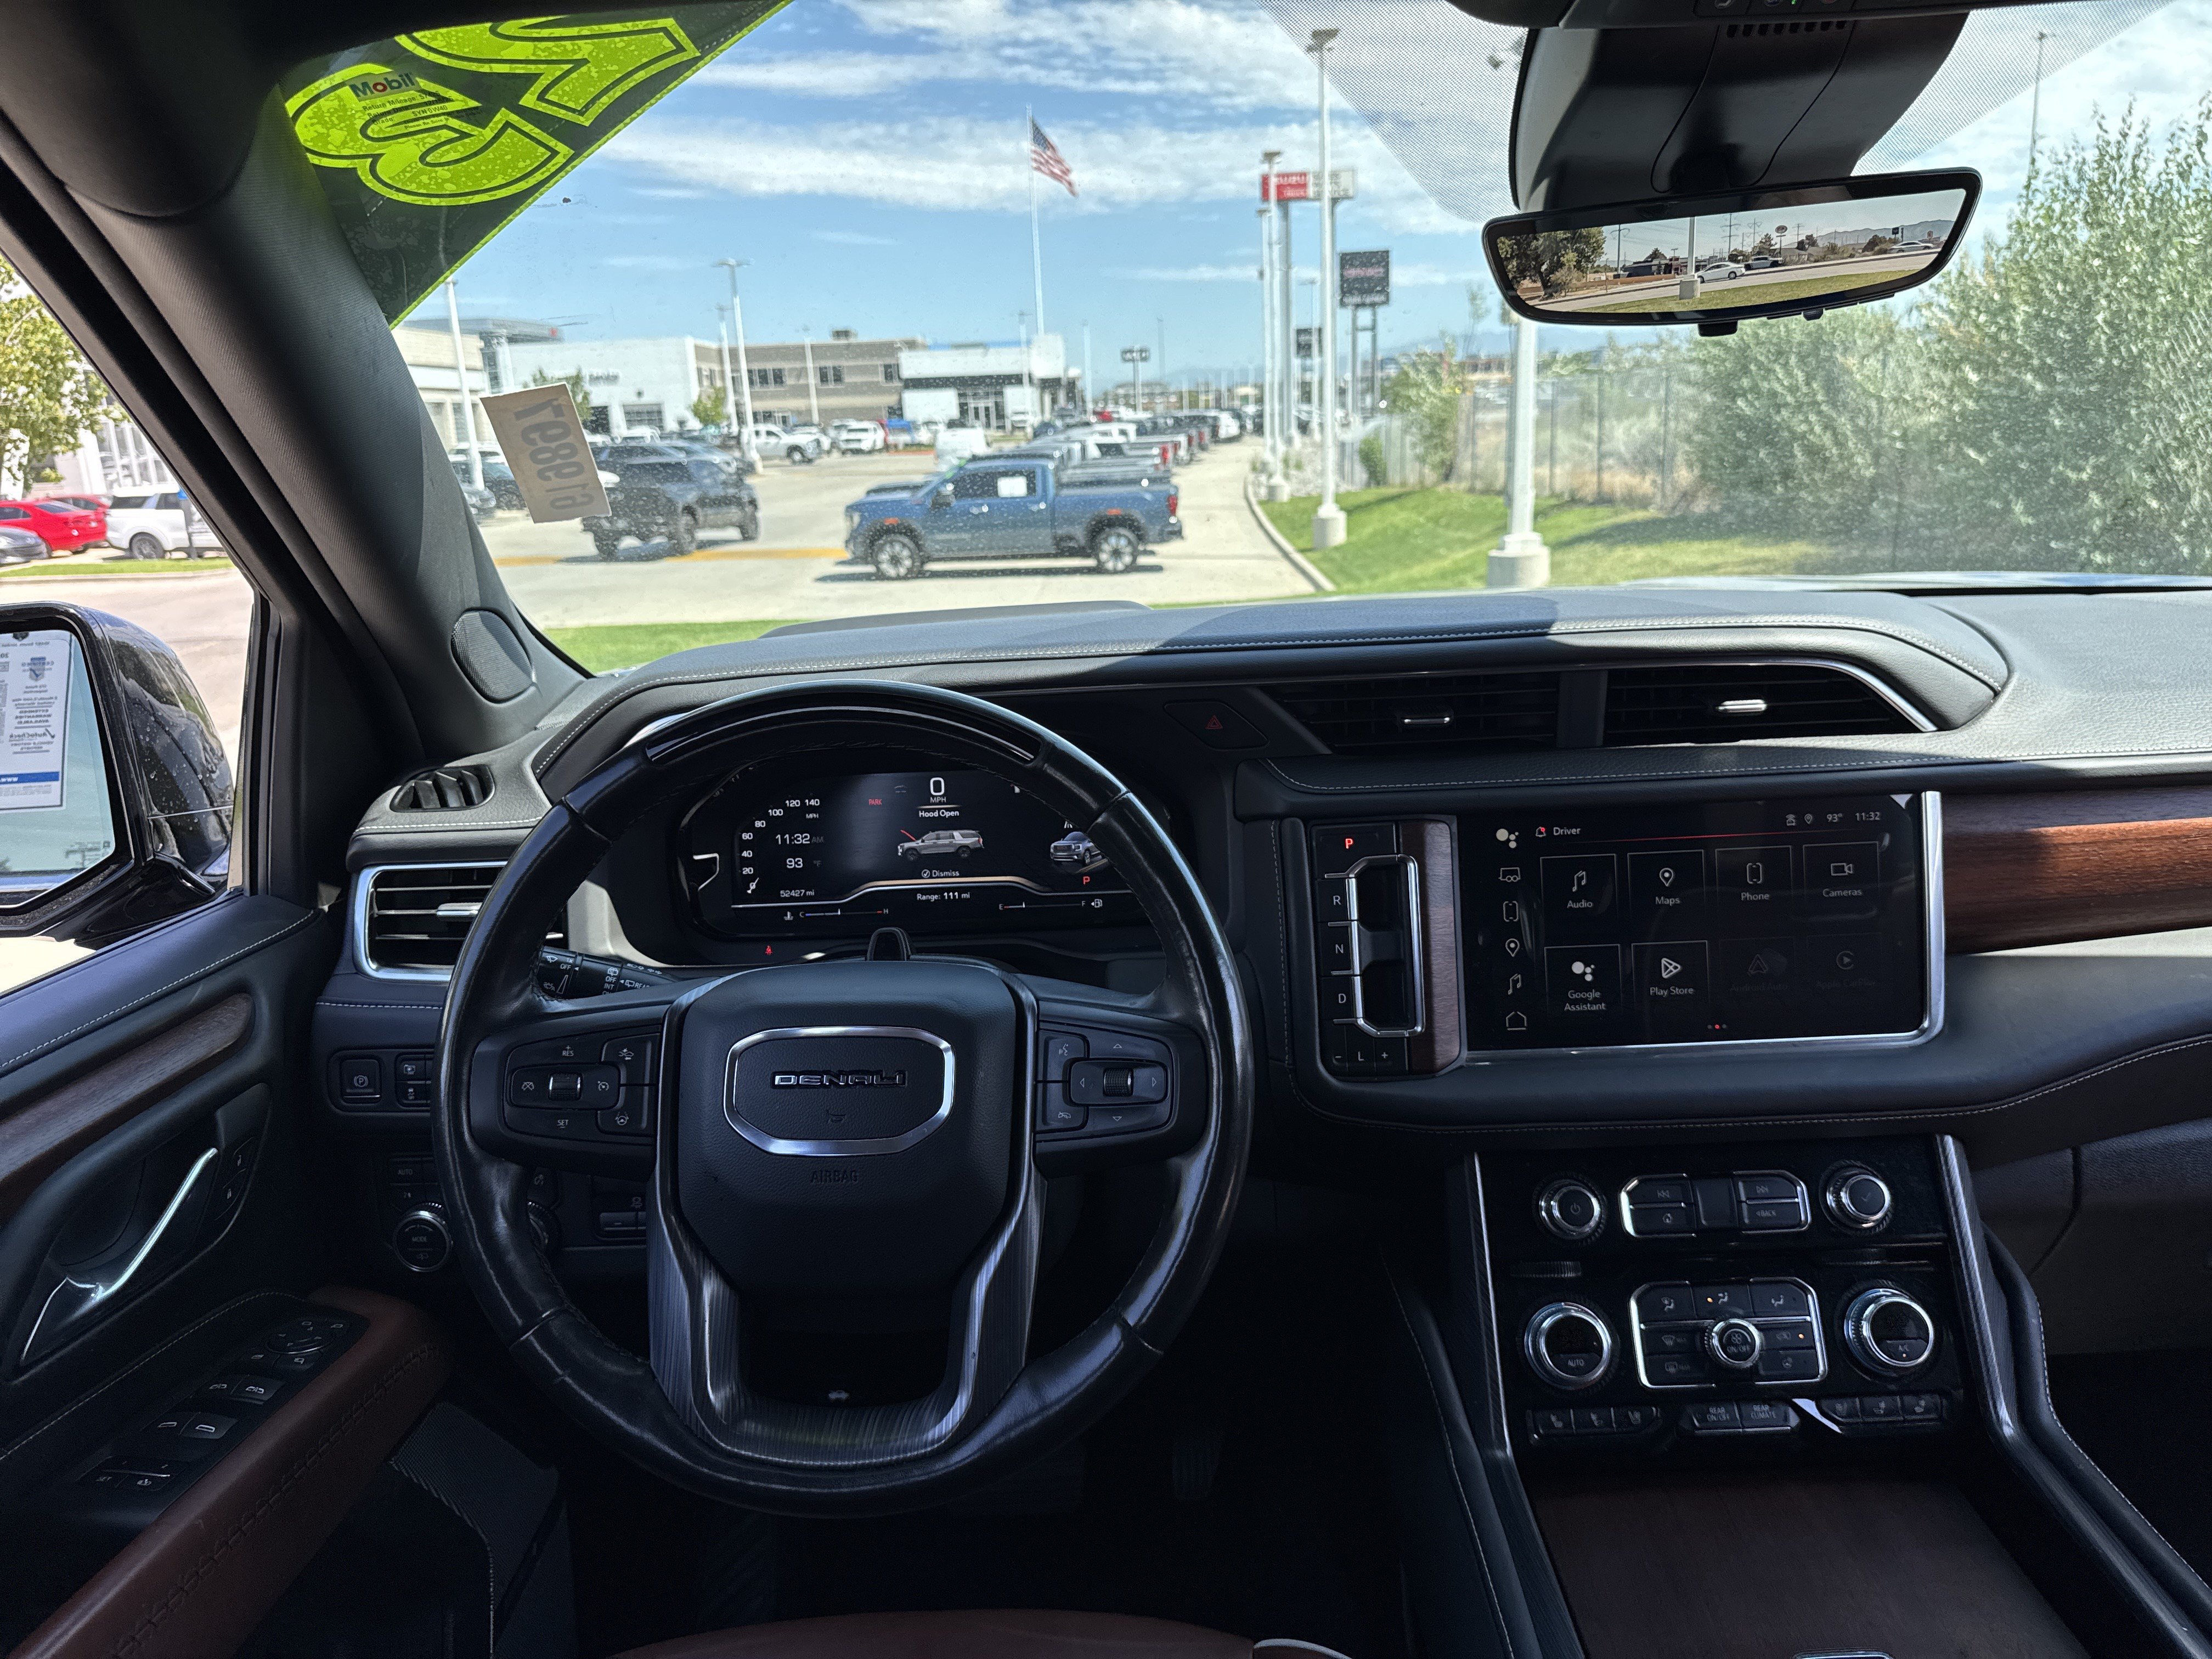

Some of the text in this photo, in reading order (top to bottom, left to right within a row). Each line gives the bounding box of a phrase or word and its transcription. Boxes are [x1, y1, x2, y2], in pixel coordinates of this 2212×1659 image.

[349, 73, 415, 98] Mobil
[362, 103, 387, 111] Return
[387, 97, 417, 106] Mileage:
[930, 777, 945, 795] 0
[918, 809, 960, 818] Hood Open
[1826, 812, 1881, 822] 93° 11:32
[1553, 827, 1581, 836] Driver
[775, 833, 810, 844] 11:32
[1345, 838, 1353, 849] P
[786, 858, 803, 868] 93
[1083, 876, 1090, 885] P
[917, 893, 941, 902] Range:
[944, 891, 958, 900] 111
[1741, 892, 1770, 901] Phone
[1822, 888, 1863, 898] Cameras
[1333, 895, 1341, 906] R
[1567, 900, 1593, 909] Audio
[1655, 896, 1680, 906] Maps
[1335, 944, 1344, 954] N
[1568, 989, 1600, 1001] Google
[1650, 986, 1695, 998] Play Store
[1339, 994, 1346, 1004] D
[1564, 1002, 1606, 1012] Assistant
[1358, 1051, 1364, 1061] L
[775, 1074, 905, 1086] DENALI
[810, 1170, 859, 1184] AIRBAG
[1567, 1359, 1585, 1367] AUTO
